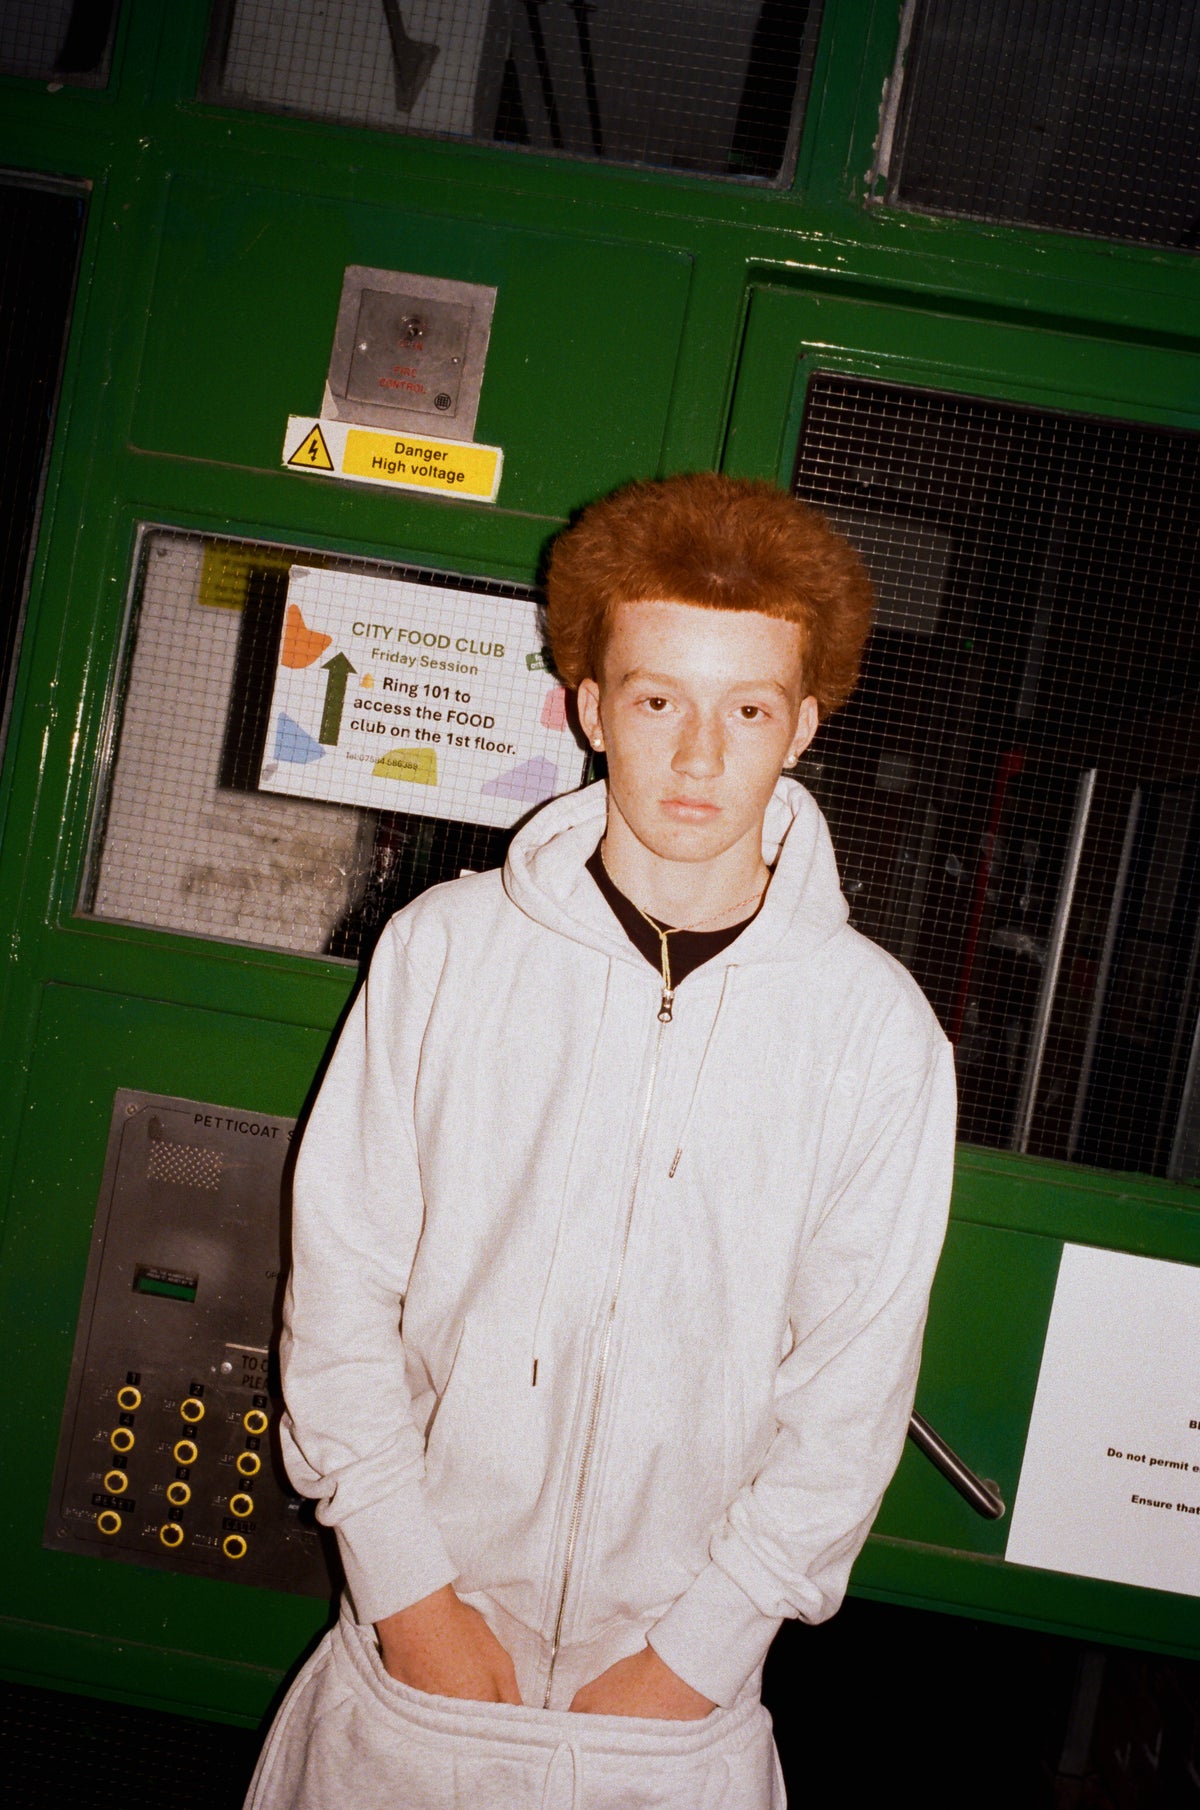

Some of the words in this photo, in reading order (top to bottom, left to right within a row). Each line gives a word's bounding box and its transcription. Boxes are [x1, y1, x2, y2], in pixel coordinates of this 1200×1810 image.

[378, 377, 427, 395] CONTROL
[394, 442, 448, 462] Danger
[371, 456, 406, 474] High
[411, 465, 465, 484] voltage
[352, 621, 393, 640] CITY
[397, 628, 451, 649] FOOD
[455, 638, 505, 658] CLUB
[371, 647, 417, 668] Friday
[420, 655, 479, 676] Session
[383, 677, 419, 698] Ring
[423, 684, 449, 700] 101
[455, 690, 471, 703] to
[353, 697, 412, 717] access
[416, 706, 442, 721] the
[446, 710, 495, 729] FOOD
[350, 718, 386, 735] club
[390, 726, 410, 738] on
[415, 728, 441, 743] the
[446, 733, 471, 748] 1st
[474, 736, 516, 755] floor.
[194, 1113, 280, 1139] PETTICOAT
[242, 1355, 258, 1370] TO
[1107, 1447, 1123, 1458] Do
[1126, 1453, 1146, 1463] not
[1149, 1457, 1189, 1471] permit
[1131, 1494, 1173, 1510] Ensure
[1176, 1503, 1200, 1515] that
